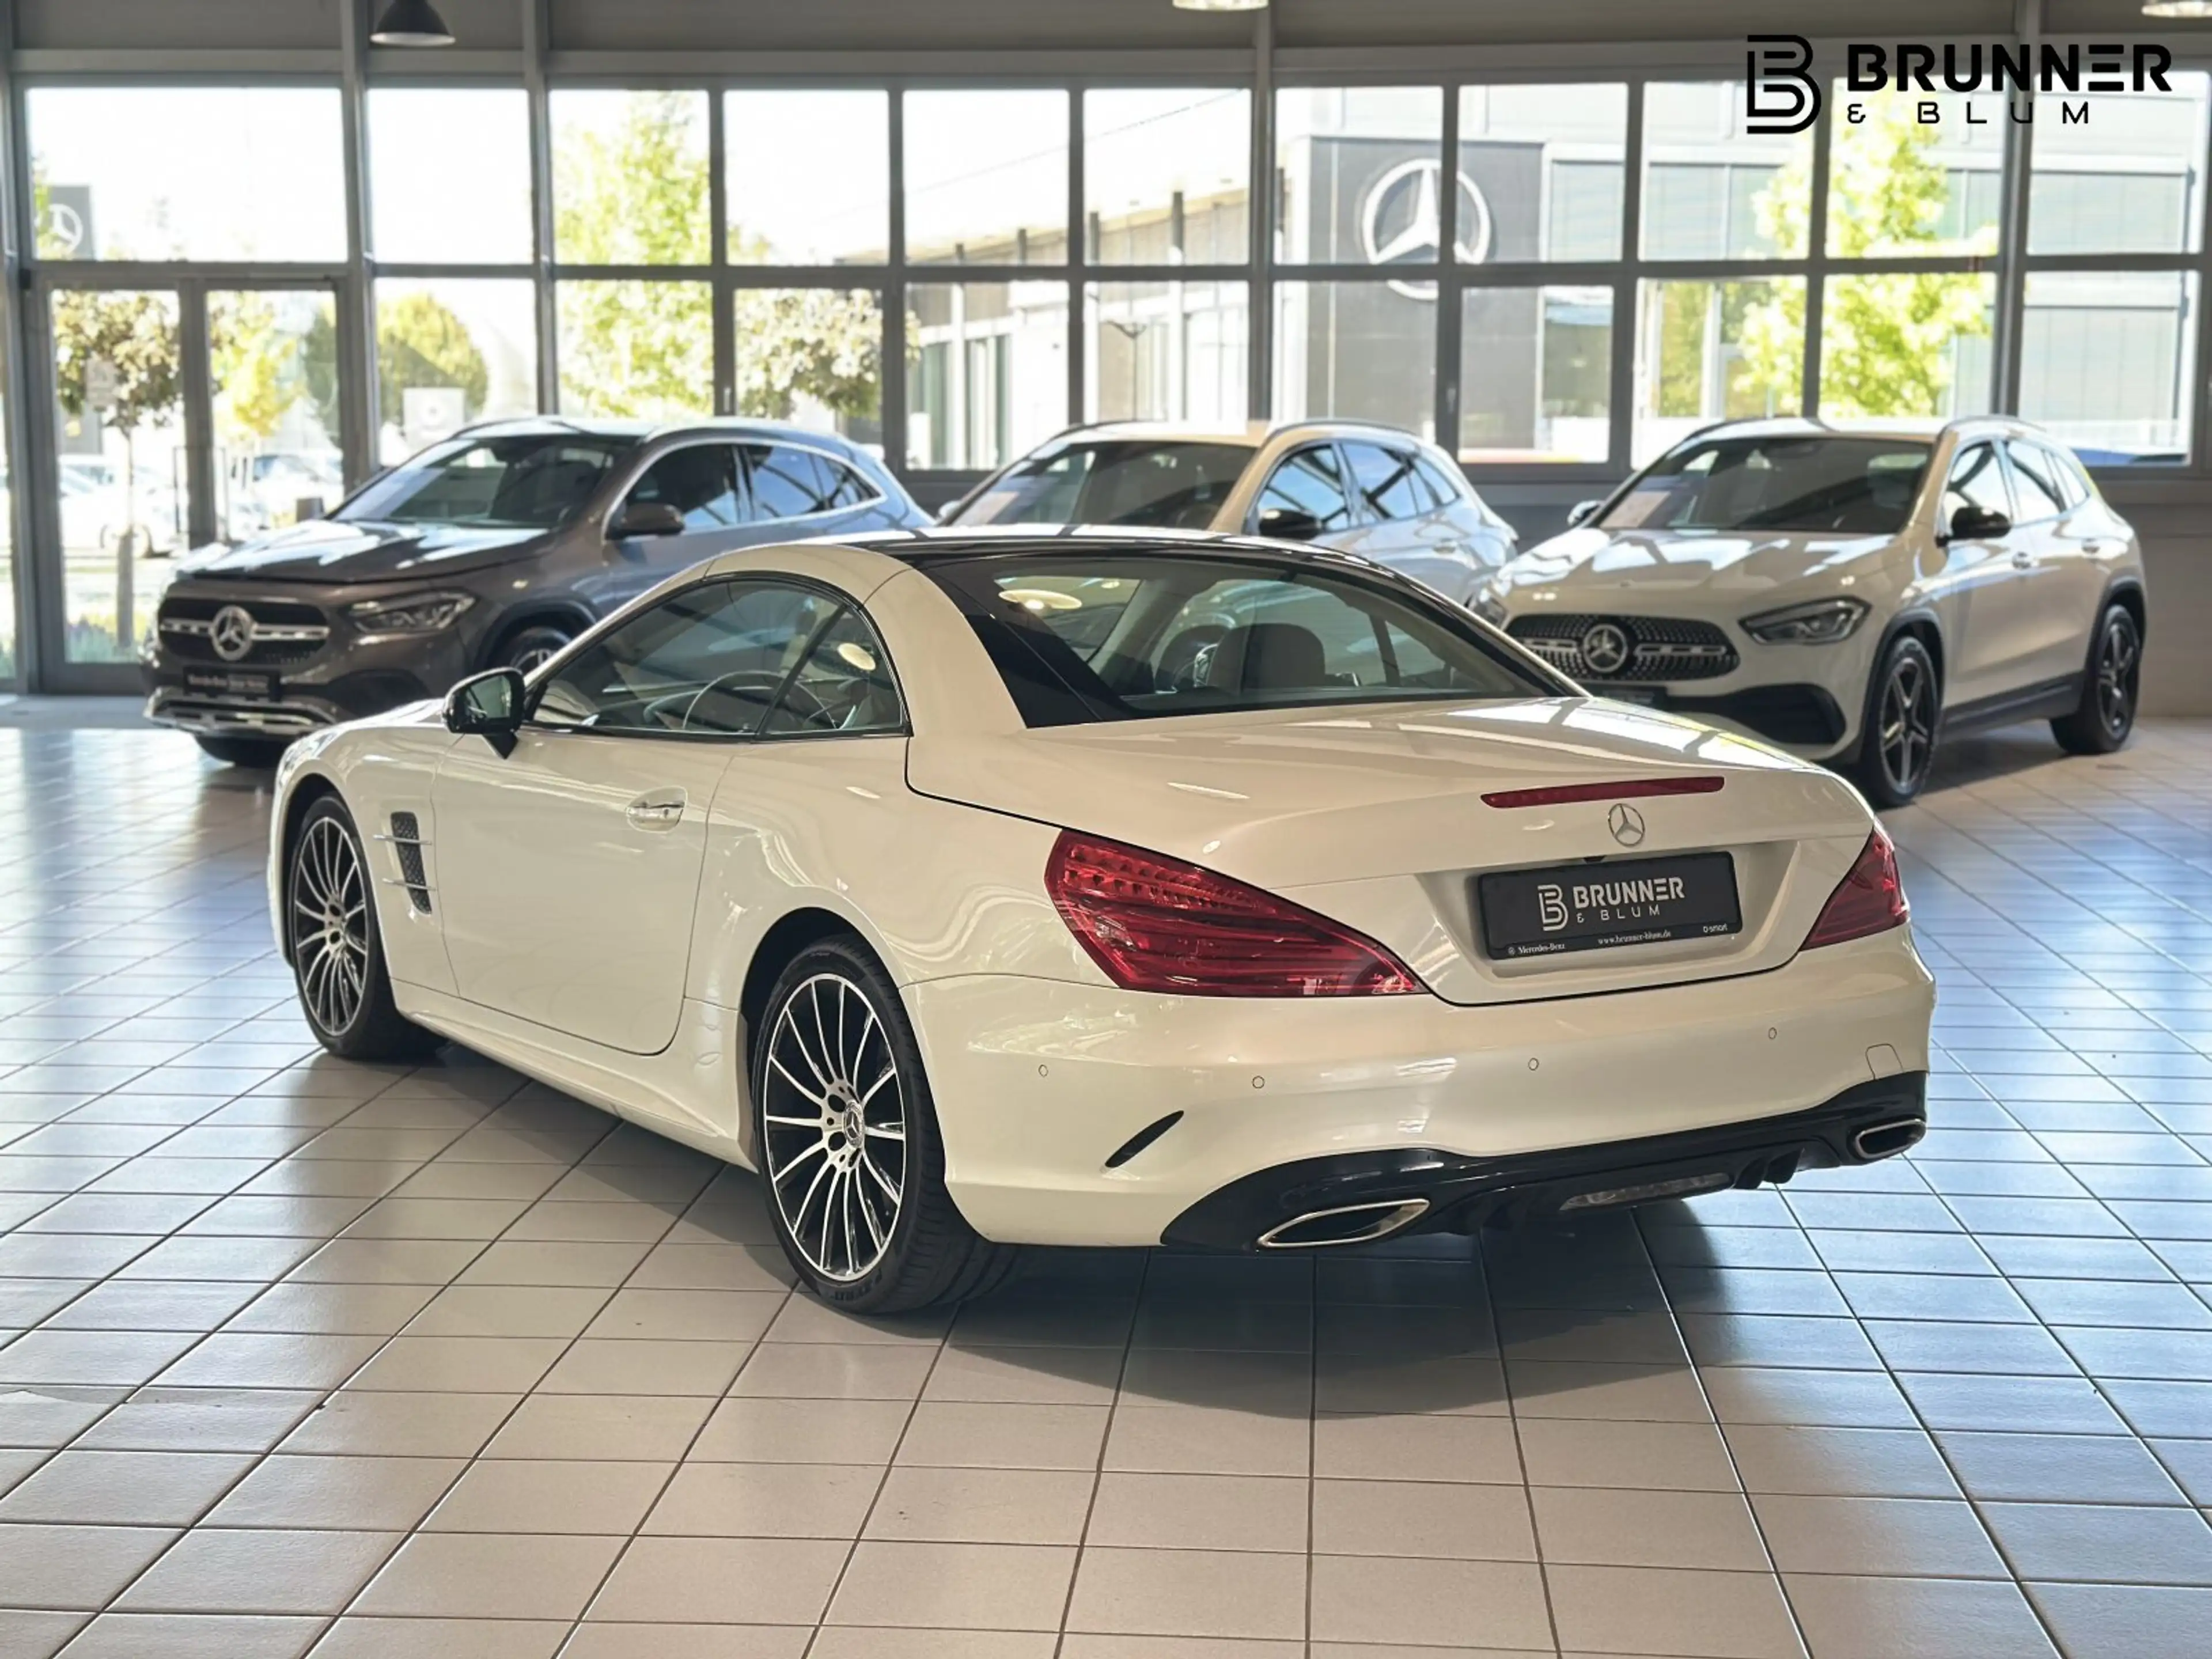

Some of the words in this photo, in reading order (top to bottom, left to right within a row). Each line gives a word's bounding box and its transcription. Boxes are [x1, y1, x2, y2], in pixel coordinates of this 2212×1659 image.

[1573, 876, 1685, 909] BRUNNER
[1600, 904, 1660, 921] BLUM
[1517, 943, 1565, 954] Mercedes-Benz
